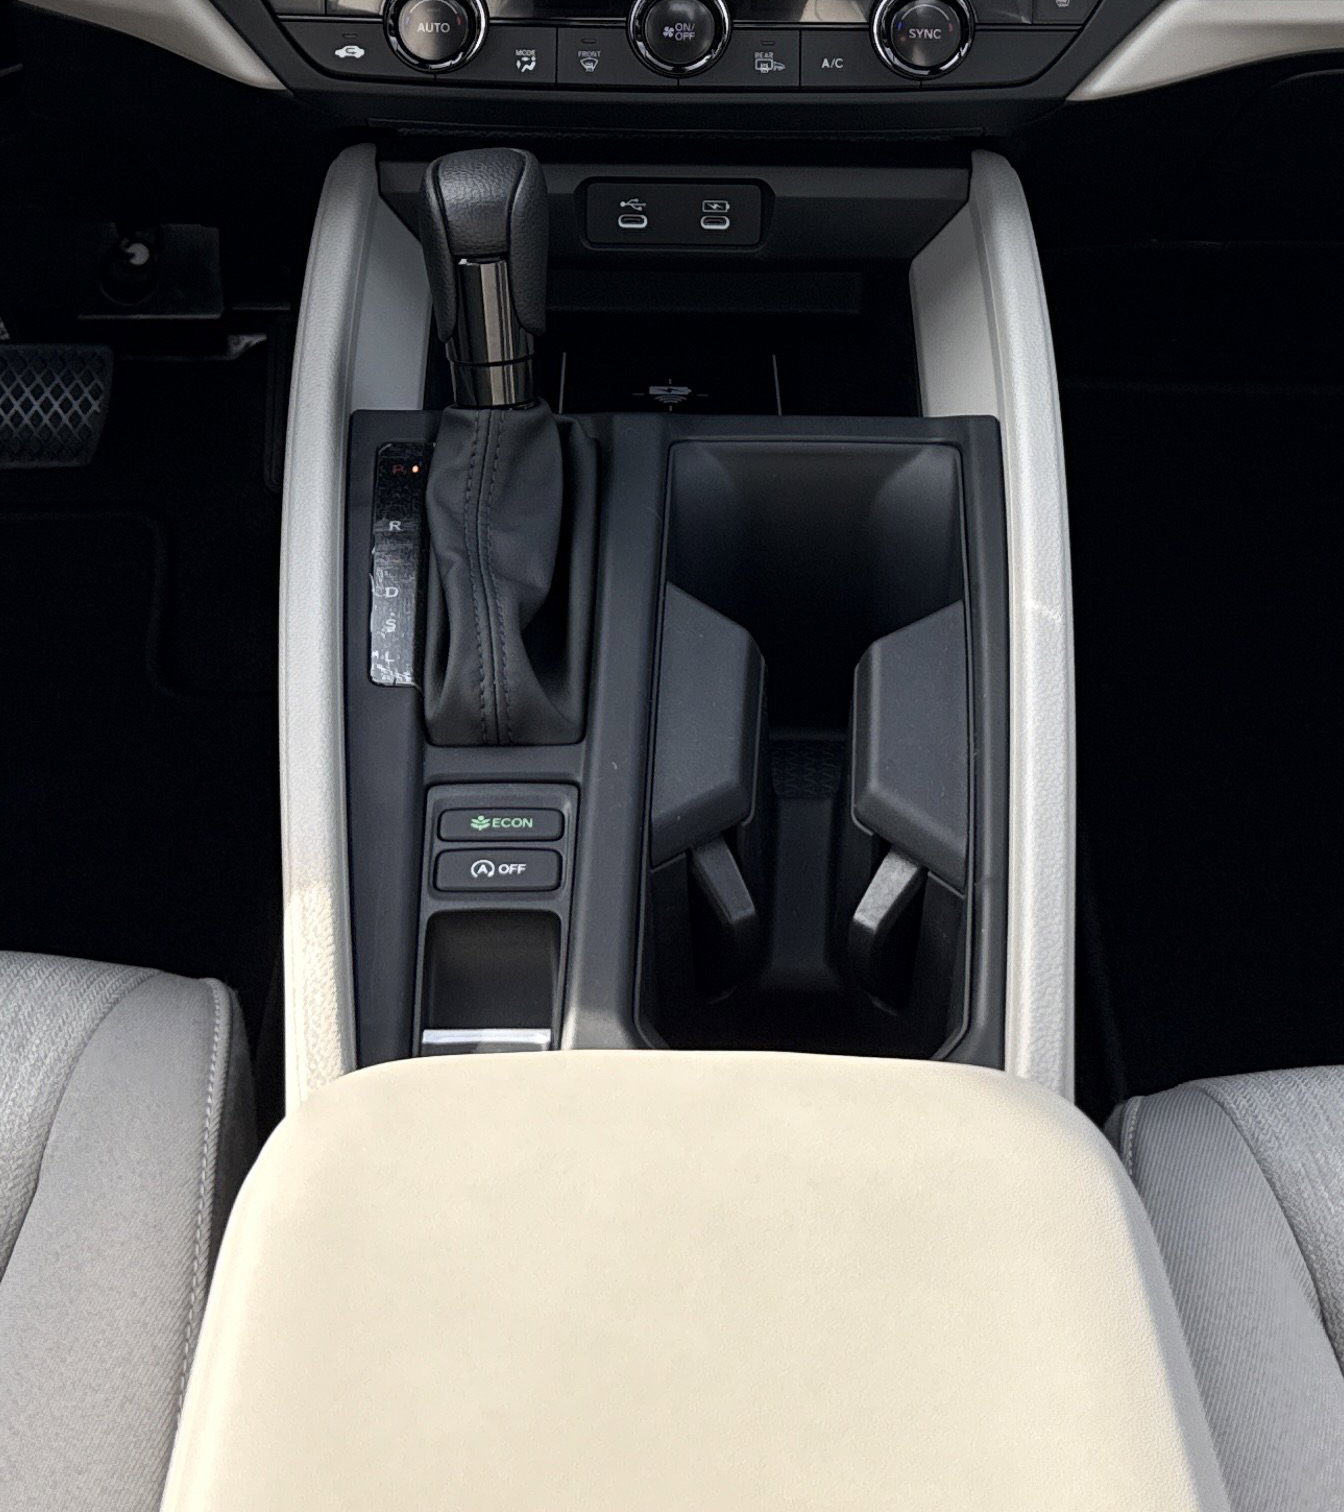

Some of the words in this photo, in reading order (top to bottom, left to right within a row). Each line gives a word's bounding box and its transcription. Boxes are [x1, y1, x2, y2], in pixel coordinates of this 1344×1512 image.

[416, 21, 451, 34] AUTO
[674, 21, 696, 32] ON/
[674, 31, 696, 42] OFF
[908, 28, 942, 40] SYNC
[515, 48, 536, 57] MODE
[577, 49, 602, 58] FRONT
[821, 57, 844, 69] A/C
[389, 520, 402, 531] R
[384, 586, 399, 598] D
[385, 618, 397, 633] S
[492, 817, 534, 829] ECON
[497, 863, 527, 875] OFF
